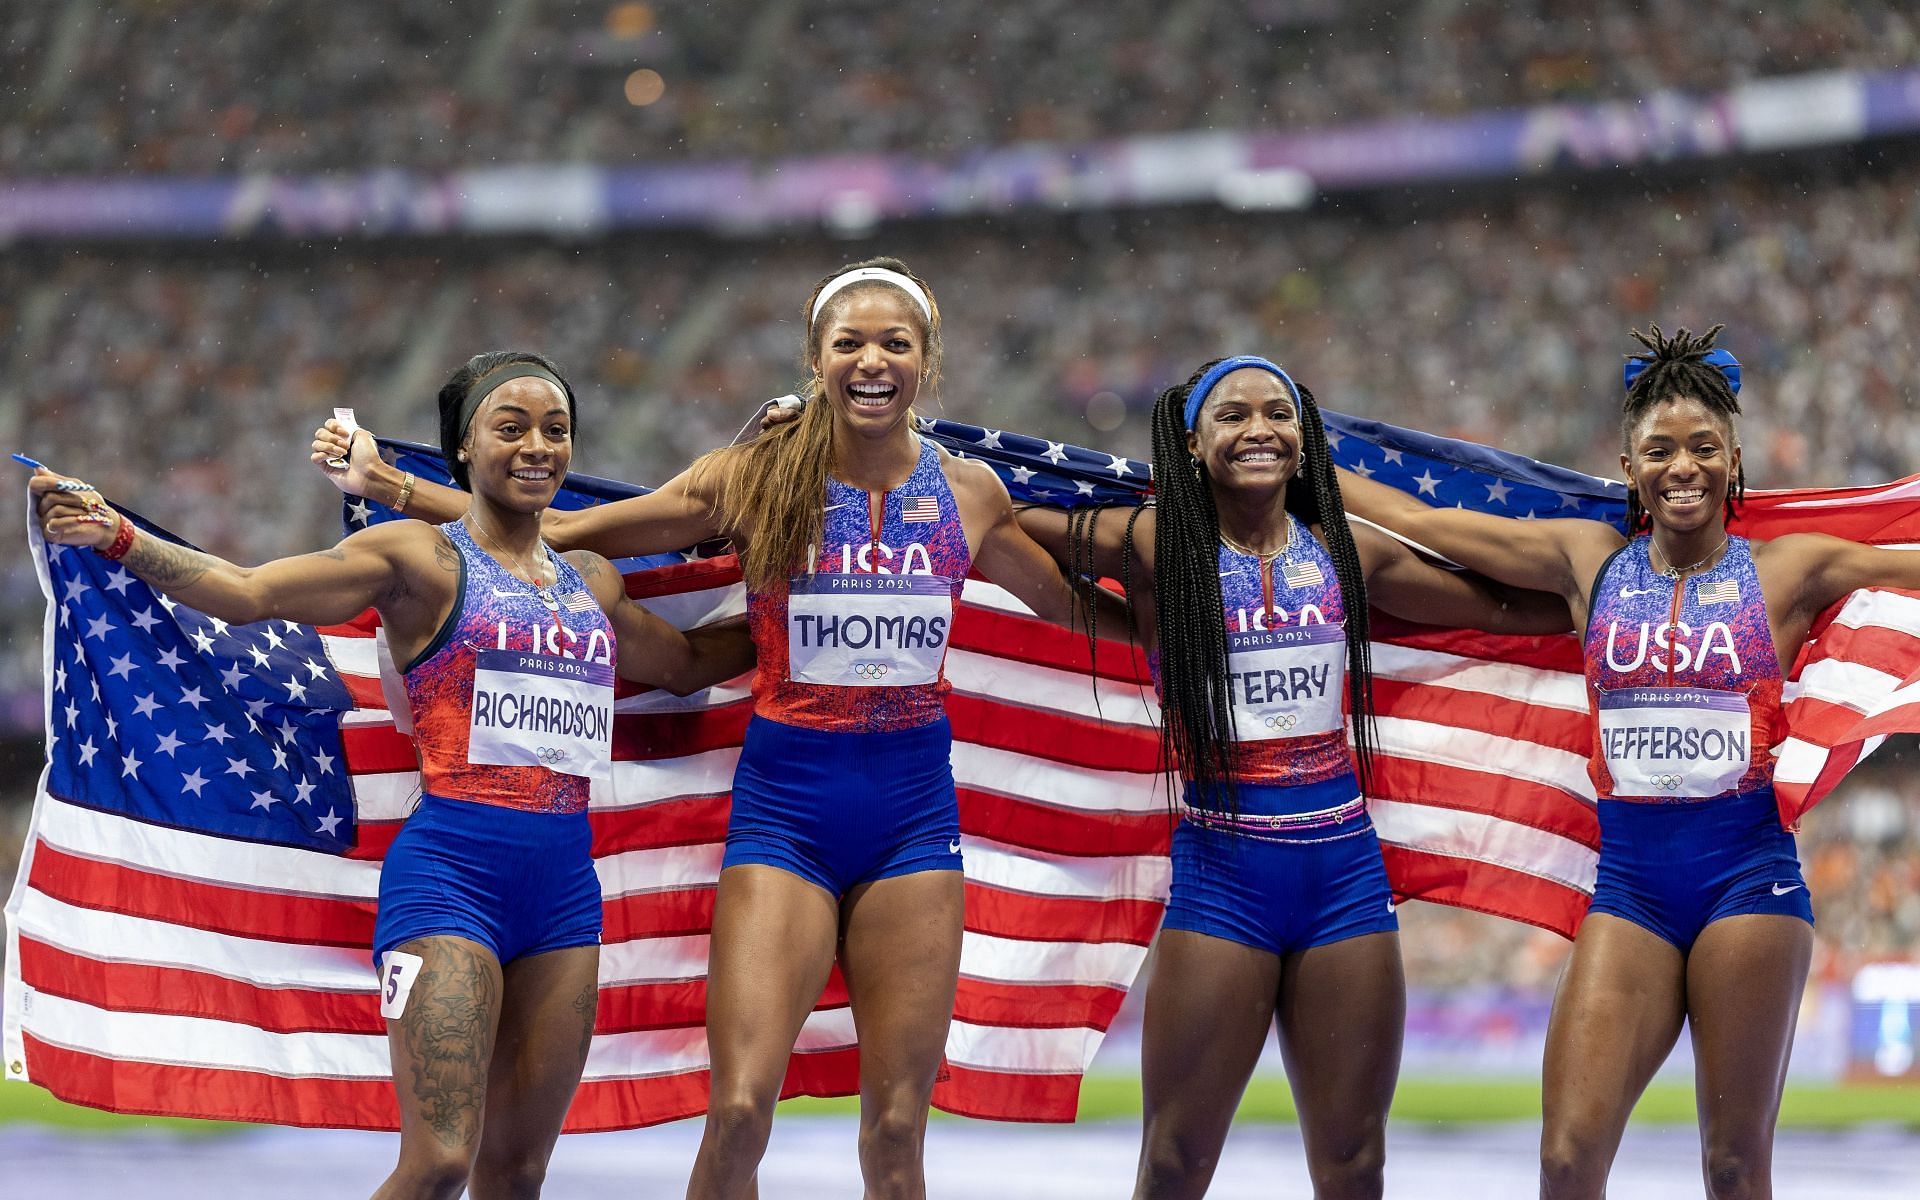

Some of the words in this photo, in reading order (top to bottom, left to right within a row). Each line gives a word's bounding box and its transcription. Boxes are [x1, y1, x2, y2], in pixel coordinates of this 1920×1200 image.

[832, 578, 872, 589] PARIS
[877, 579, 912, 589] 2024
[793, 614, 946, 649] THOMAS
[1234, 635, 1273, 647] PARIS
[1277, 631, 1312, 642] 2024
[1605, 621, 1742, 675] USA
[519, 657, 555, 671] PARIS
[558, 663, 588, 677] 2024
[1633, 693, 1670, 702] PARIS
[1675, 694, 1710, 704] 2024
[474, 690, 608, 743] RICHARDSON
[386, 965, 402, 1005] 5
